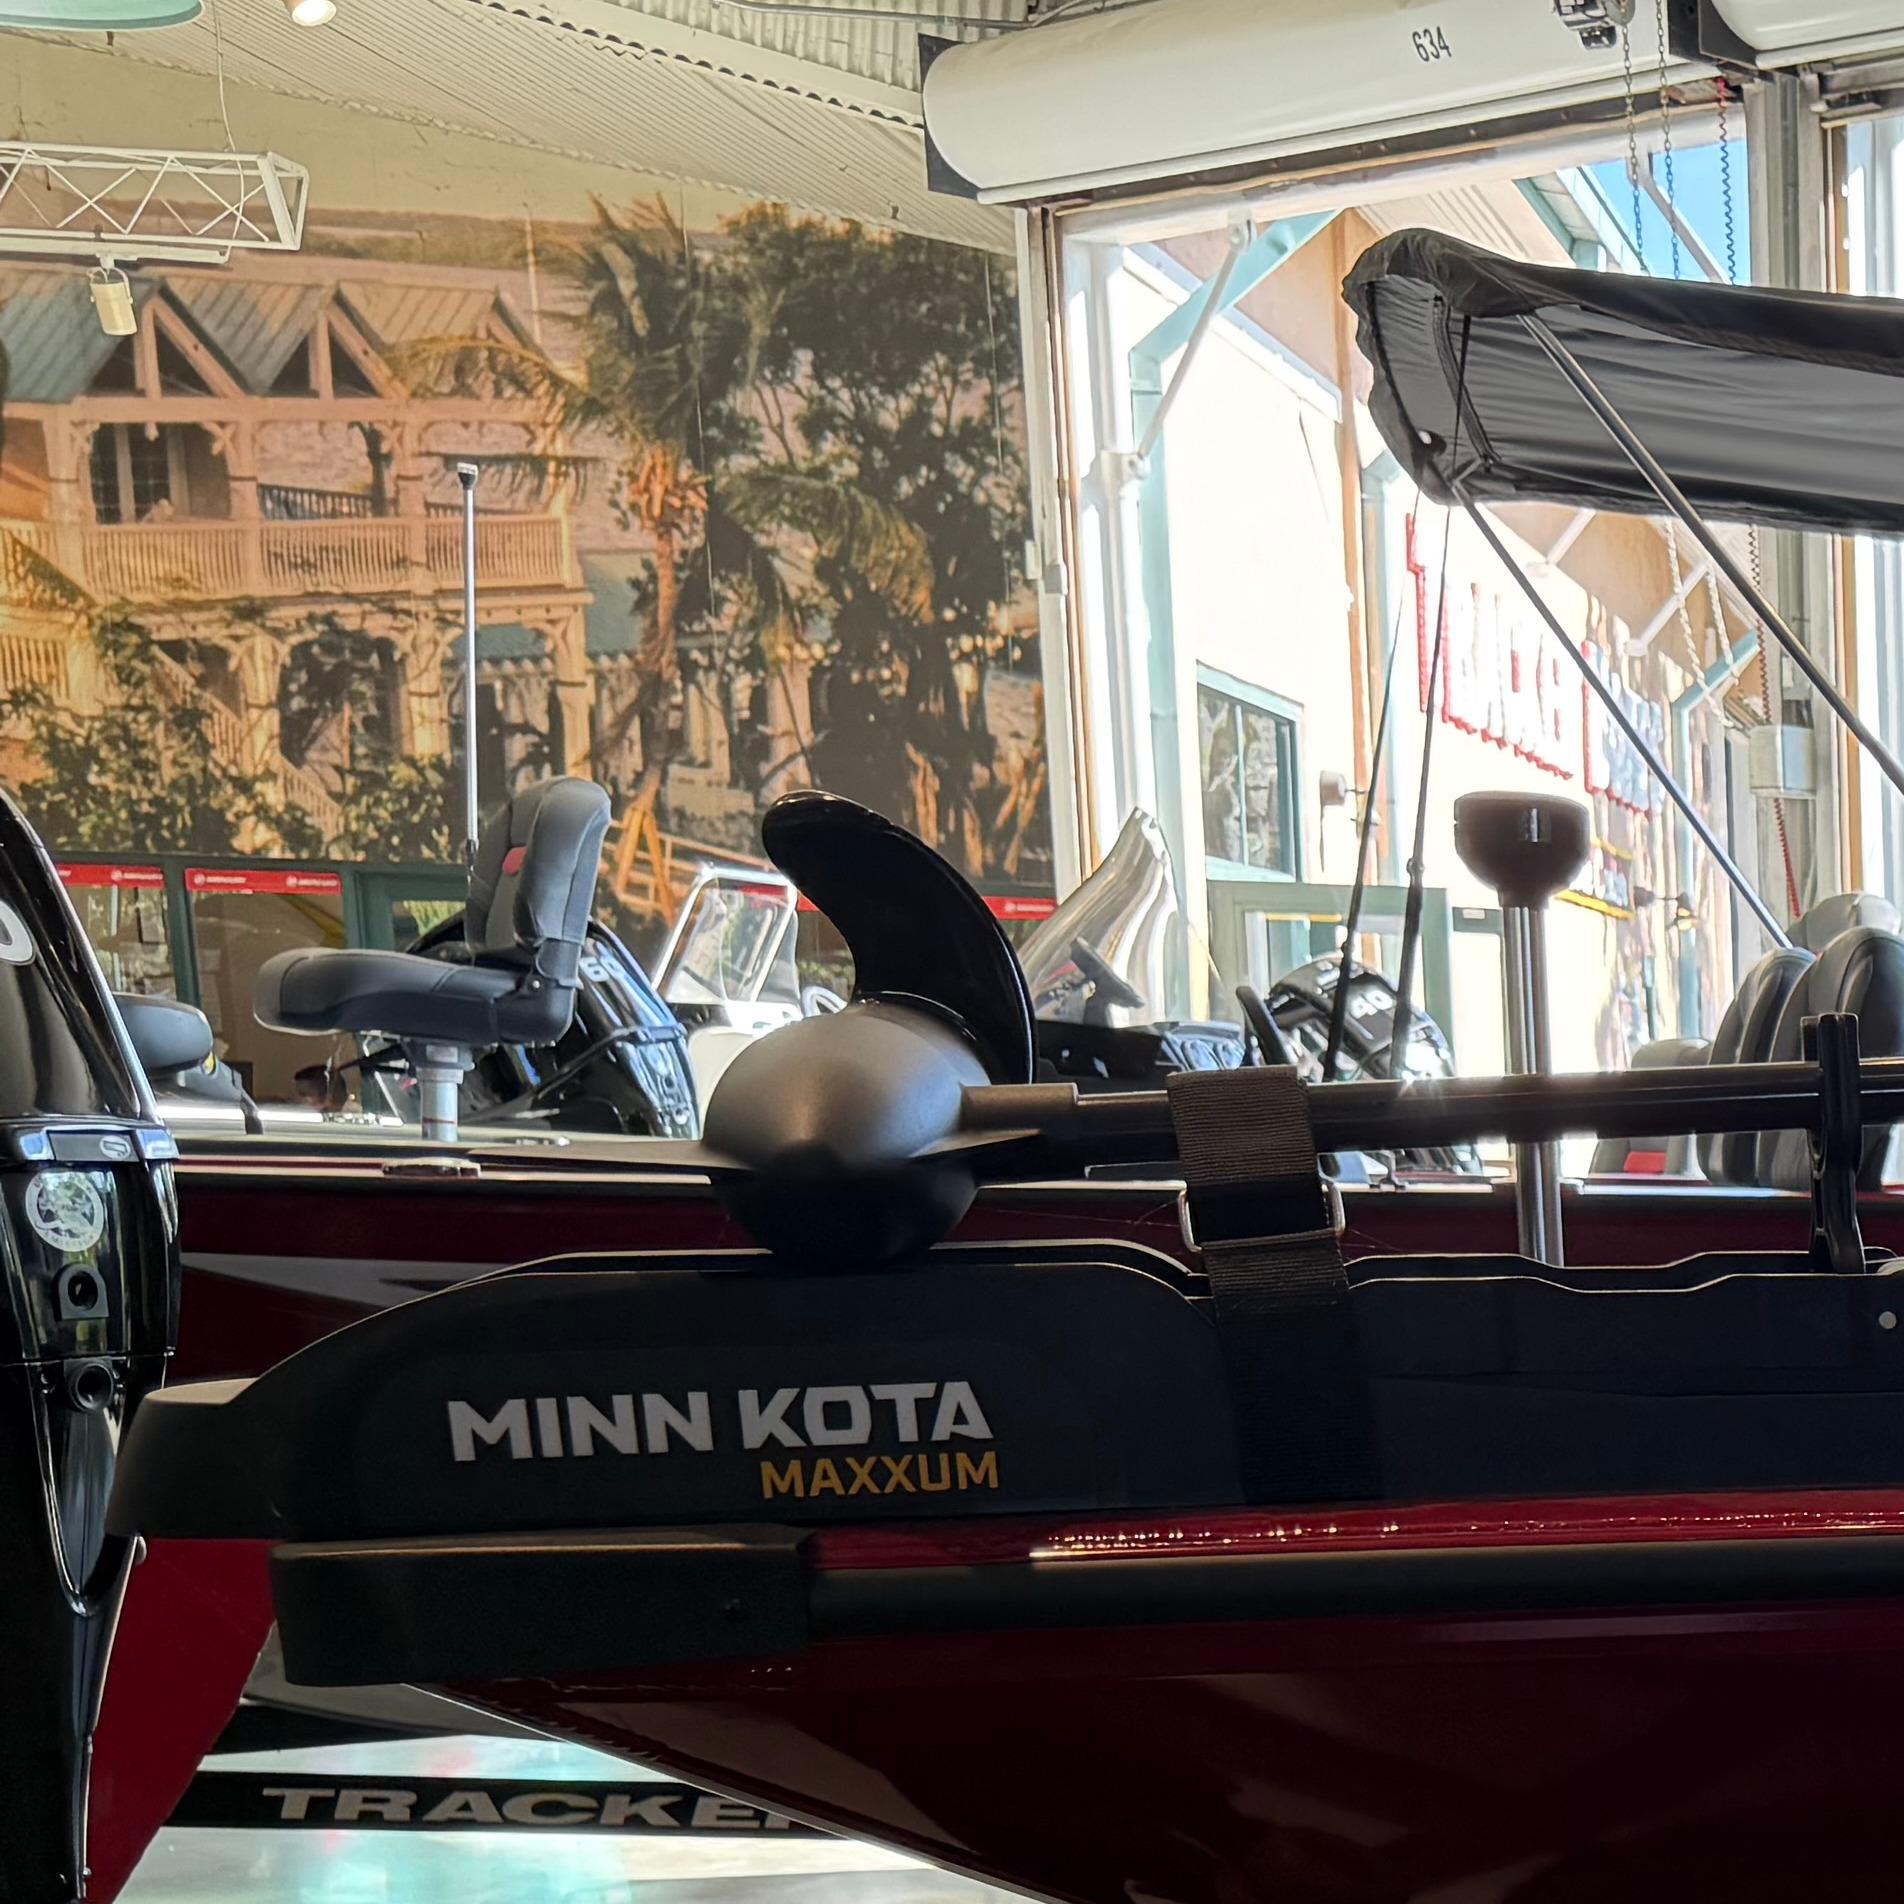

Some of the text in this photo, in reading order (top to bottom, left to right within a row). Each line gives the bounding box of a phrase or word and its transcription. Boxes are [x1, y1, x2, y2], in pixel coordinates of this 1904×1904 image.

[1412, 26, 1452, 62] 634
[448, 1381, 993, 1461] MINN KOTA
[760, 1451, 999, 1499] MAXXUM
